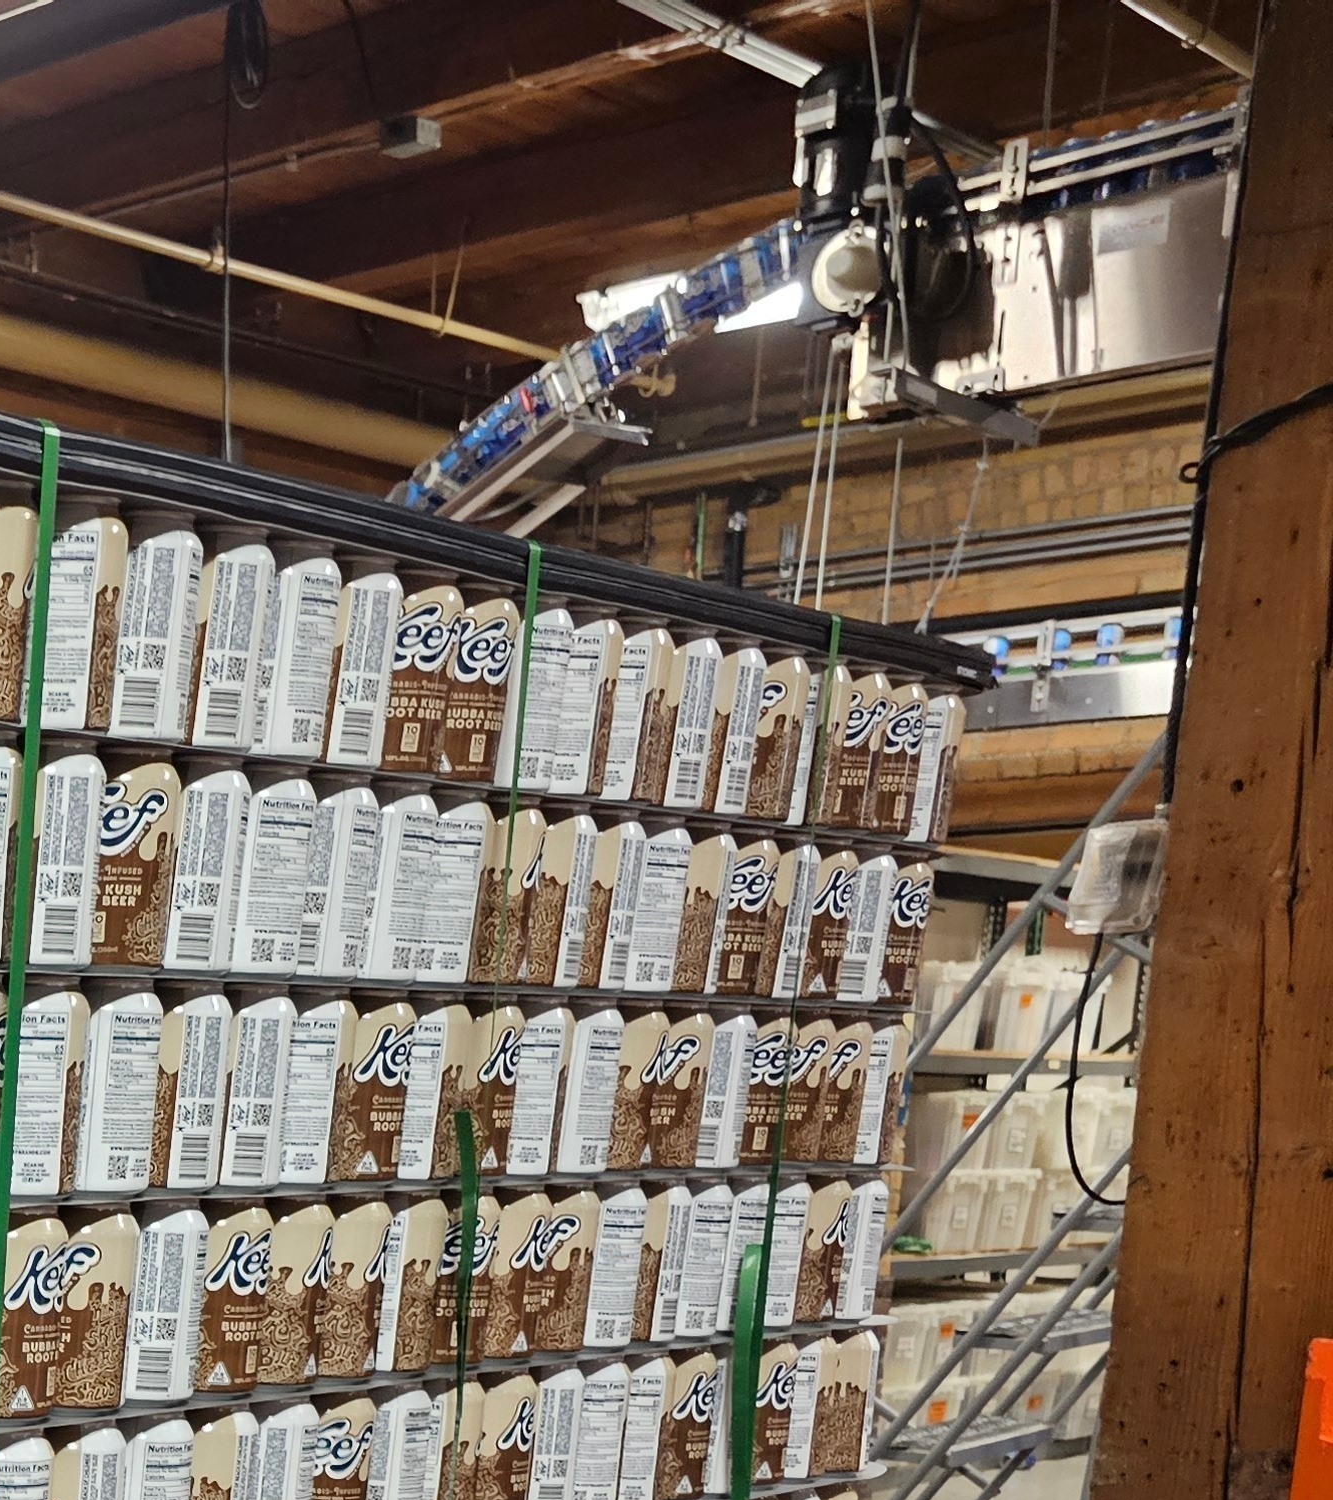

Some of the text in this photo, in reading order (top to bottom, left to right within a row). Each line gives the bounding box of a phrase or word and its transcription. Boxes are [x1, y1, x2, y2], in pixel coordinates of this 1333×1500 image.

[407, 726, 418, 734] 10
[446, 719, 482, 730] ROOT
[474, 737, 484, 745] 10
[842, 768, 870, 781] KUSH
[263, 799, 299, 812] Nutrition
[104, 884, 142, 897] KUSH
[102, 895, 136, 908] BEER
[38, 1012, 66, 1025] Facts
[115, 1014, 150, 1025] Nutrition
[307, 1020, 337, 1031] Facts
[26, 1351, 54, 1363] ROOT
[147, 1444, 183, 1456] Nutrition
